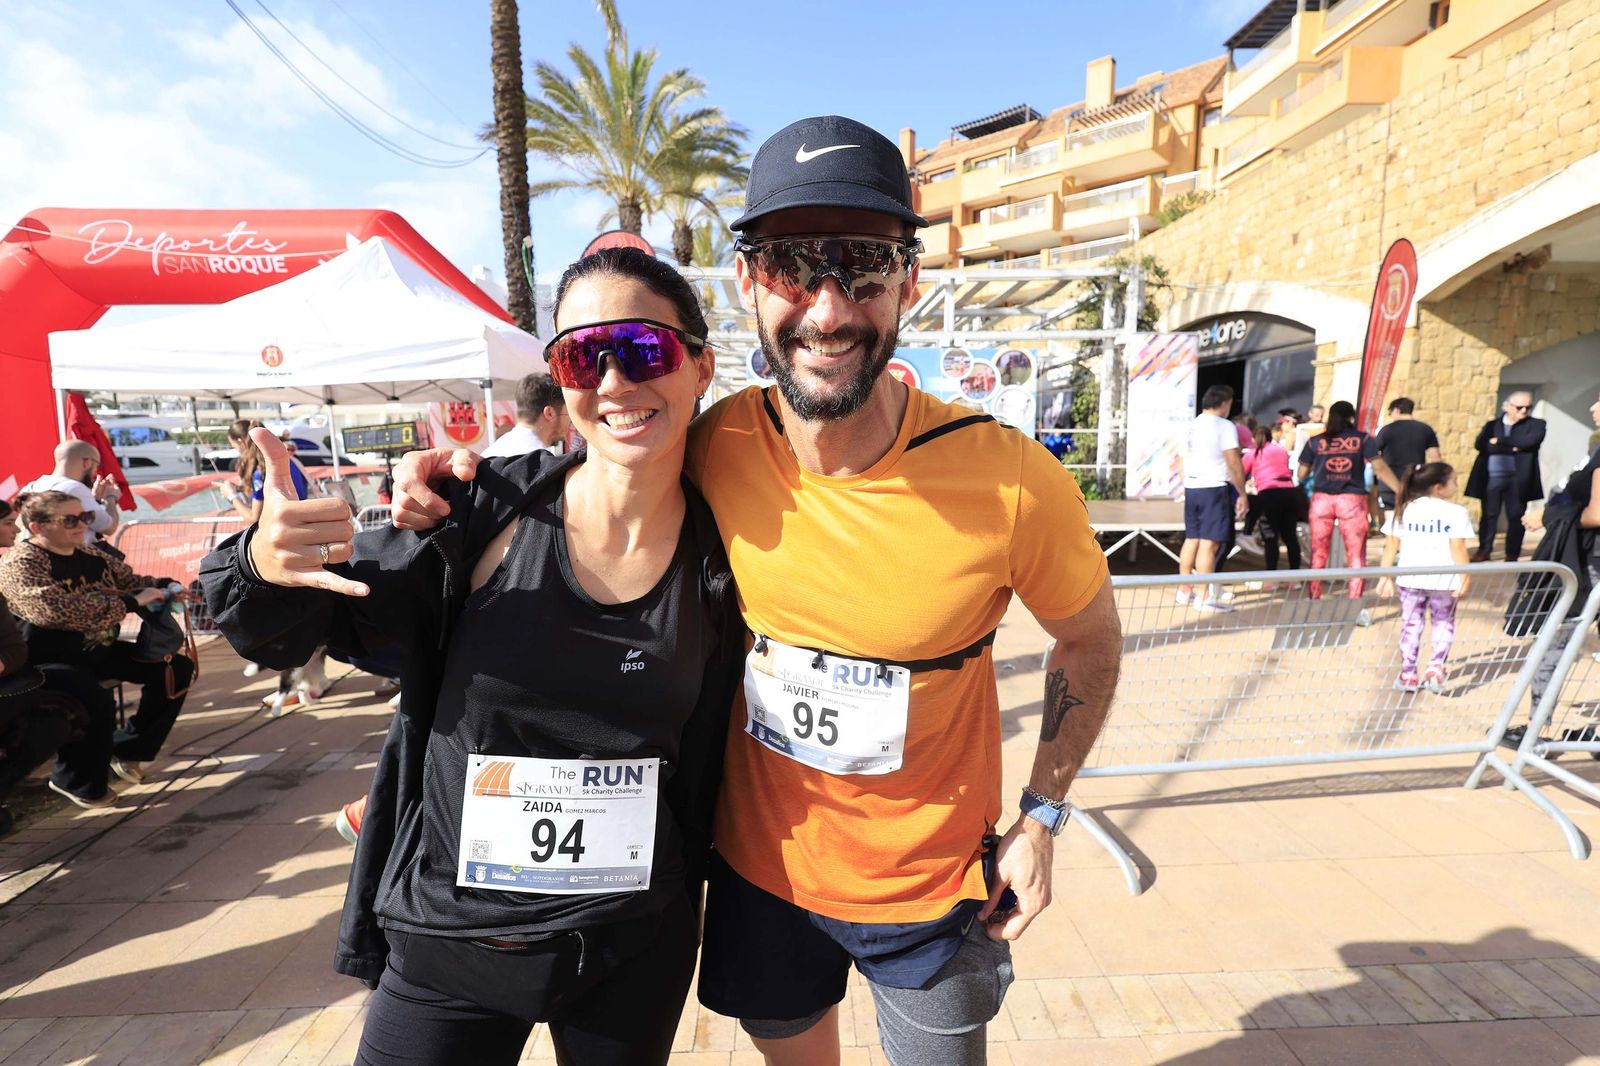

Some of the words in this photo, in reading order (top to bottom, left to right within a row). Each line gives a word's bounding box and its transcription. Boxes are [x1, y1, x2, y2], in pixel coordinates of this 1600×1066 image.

[78, 219, 288, 275] Deportes
[620, 661, 645, 674] ipso
[832, 664, 894, 688] RUN
[782, 683, 819, 700] JAVIER
[792, 701, 839, 747] 95
[881, 745, 890, 753] M
[550, 766, 577, 780] The
[582, 765, 643, 787] RUN
[582, 788, 590, 796] 5k
[591, 787, 614, 796] Charity
[614, 787, 643, 795] Challenge
[522, 800, 563, 814] ZAIDA
[530, 818, 586, 864] 94
[630, 850, 639, 860] M
[603, 874, 639, 882] BETANIA
